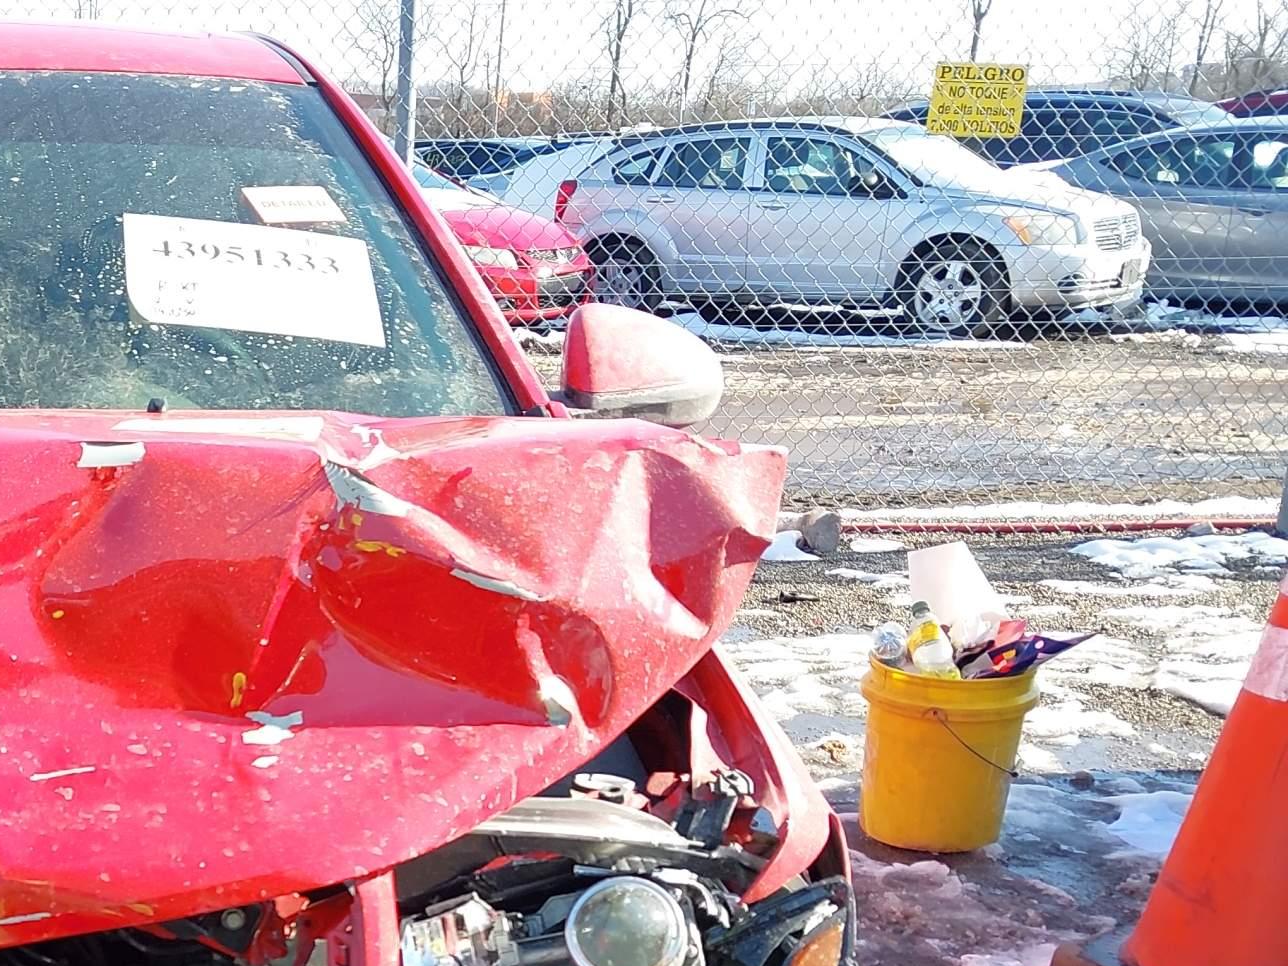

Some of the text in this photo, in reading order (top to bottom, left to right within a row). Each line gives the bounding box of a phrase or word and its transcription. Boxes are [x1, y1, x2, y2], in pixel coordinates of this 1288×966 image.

[939, 65, 1025, 82] PELIGRO
[948, 85, 1009, 100] NO TOQUE
[937, 102, 951, 115] de
[953, 103, 973, 116] alta
[930, 119, 959, 133] 7,000
[151, 239, 341, 276] 43951333
